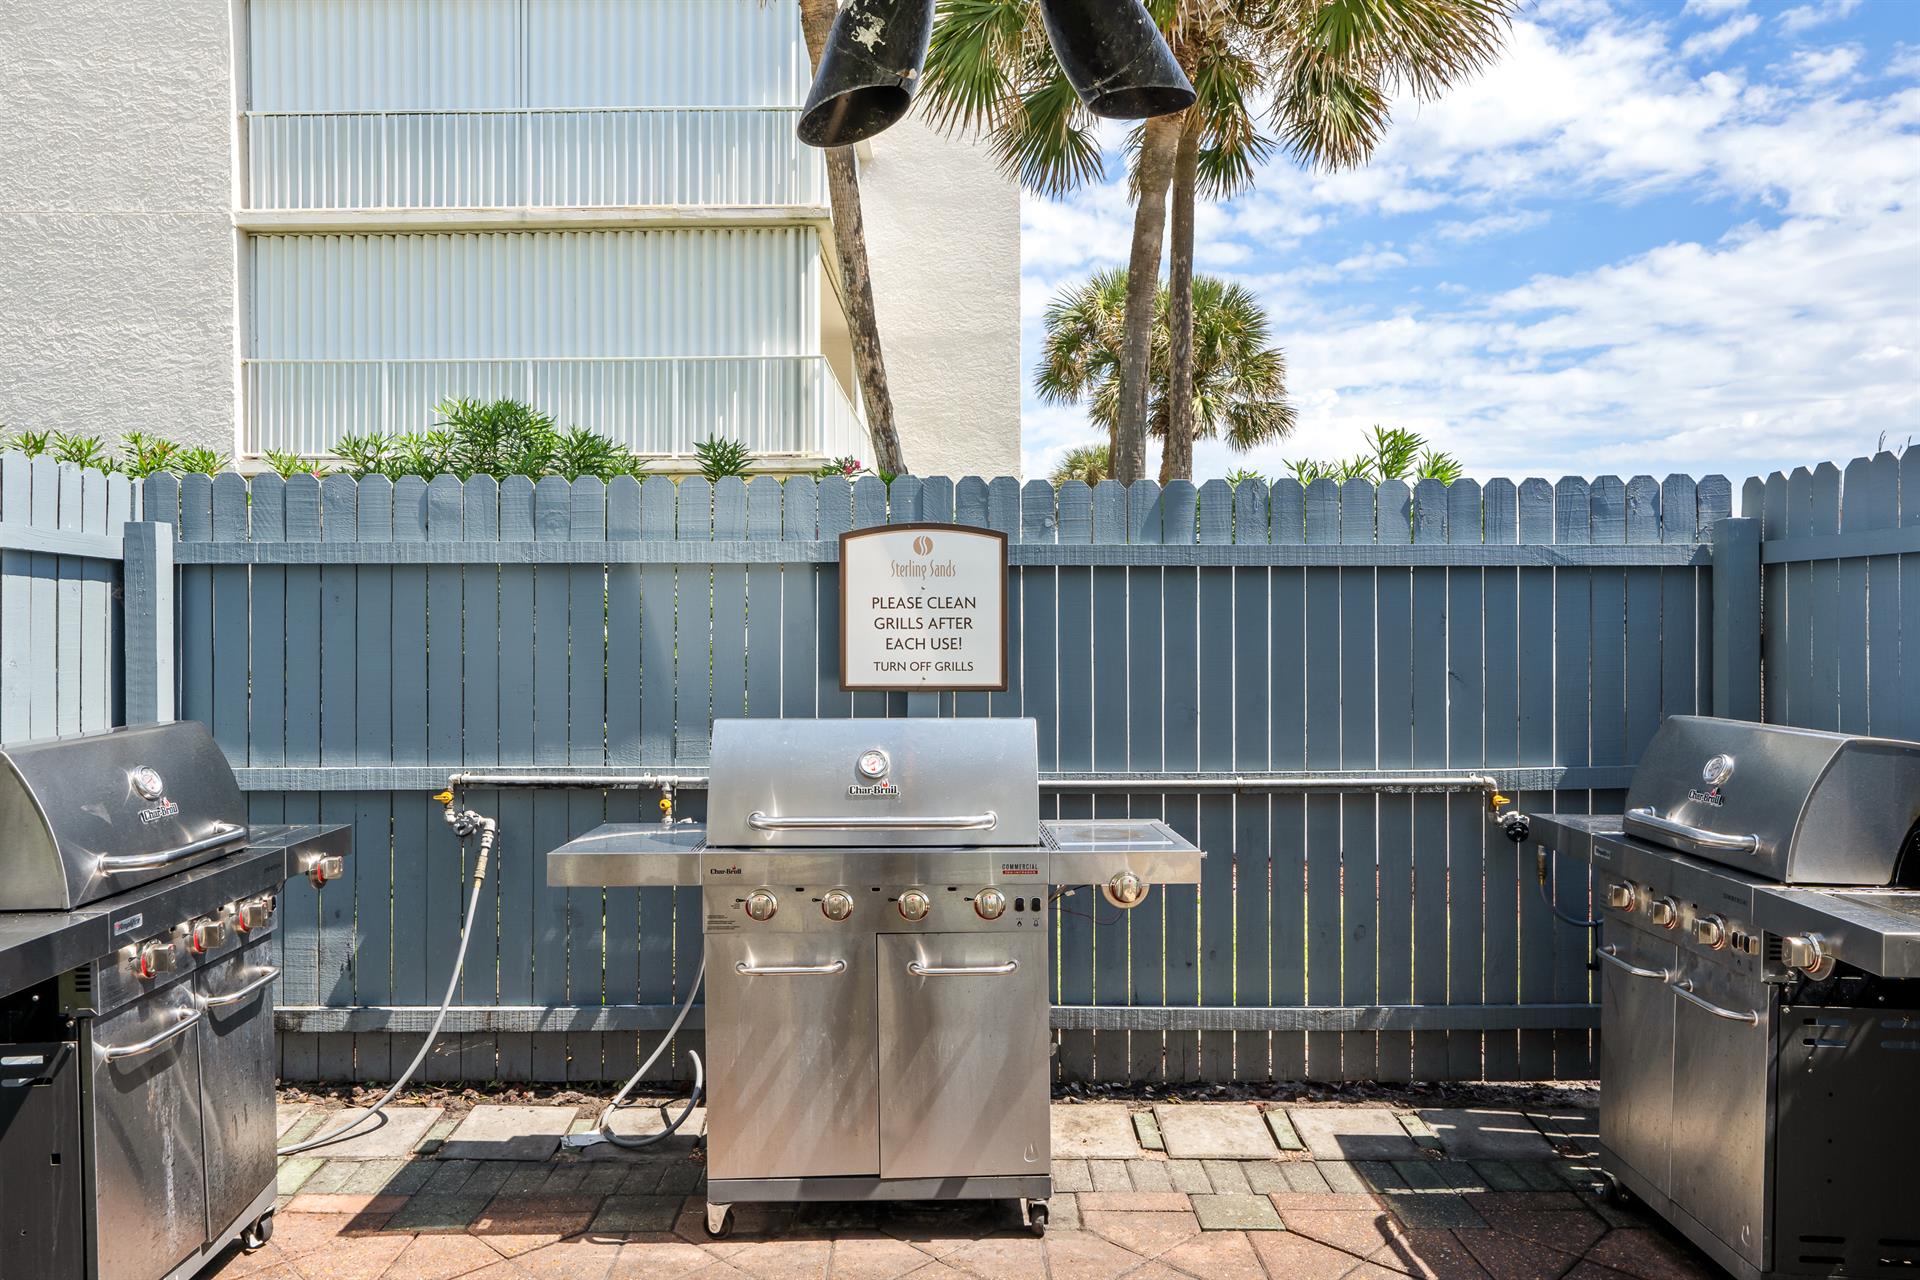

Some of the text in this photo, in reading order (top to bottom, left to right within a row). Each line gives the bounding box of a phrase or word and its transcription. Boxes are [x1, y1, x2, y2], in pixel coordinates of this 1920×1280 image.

[891, 560, 956, 580] Sterling Sands
[872, 596, 976, 609] PLEASE CLEAN
[874, 617, 973, 630] GRILLS AFTER
[885, 637, 962, 650] EACH USE!
[873, 661, 974, 672] TURN OFF GRILLS
[849, 785, 898, 795] Char-Broil
